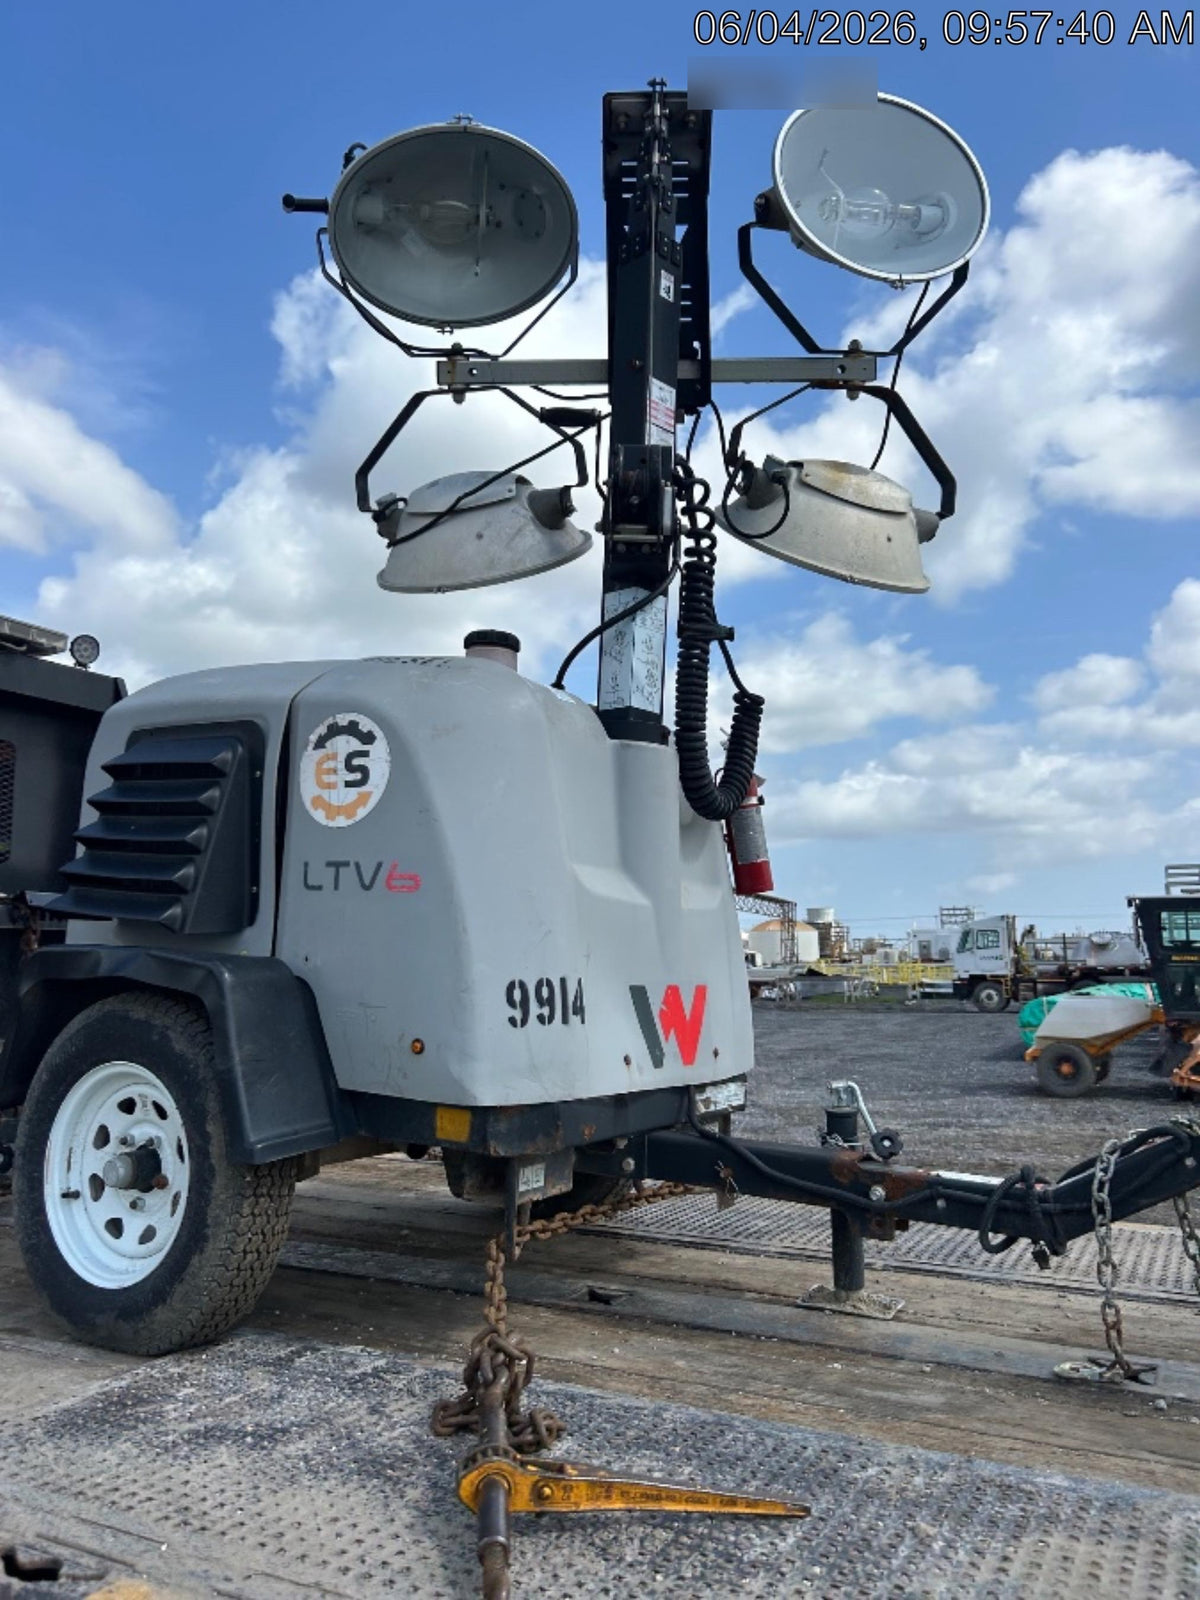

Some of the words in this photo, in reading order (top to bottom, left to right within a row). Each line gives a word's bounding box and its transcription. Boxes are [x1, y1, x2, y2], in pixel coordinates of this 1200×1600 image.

[314, 750, 370, 790] ES
[303, 860, 421, 893] LTV6
[505, 977, 585, 1029] 9914
